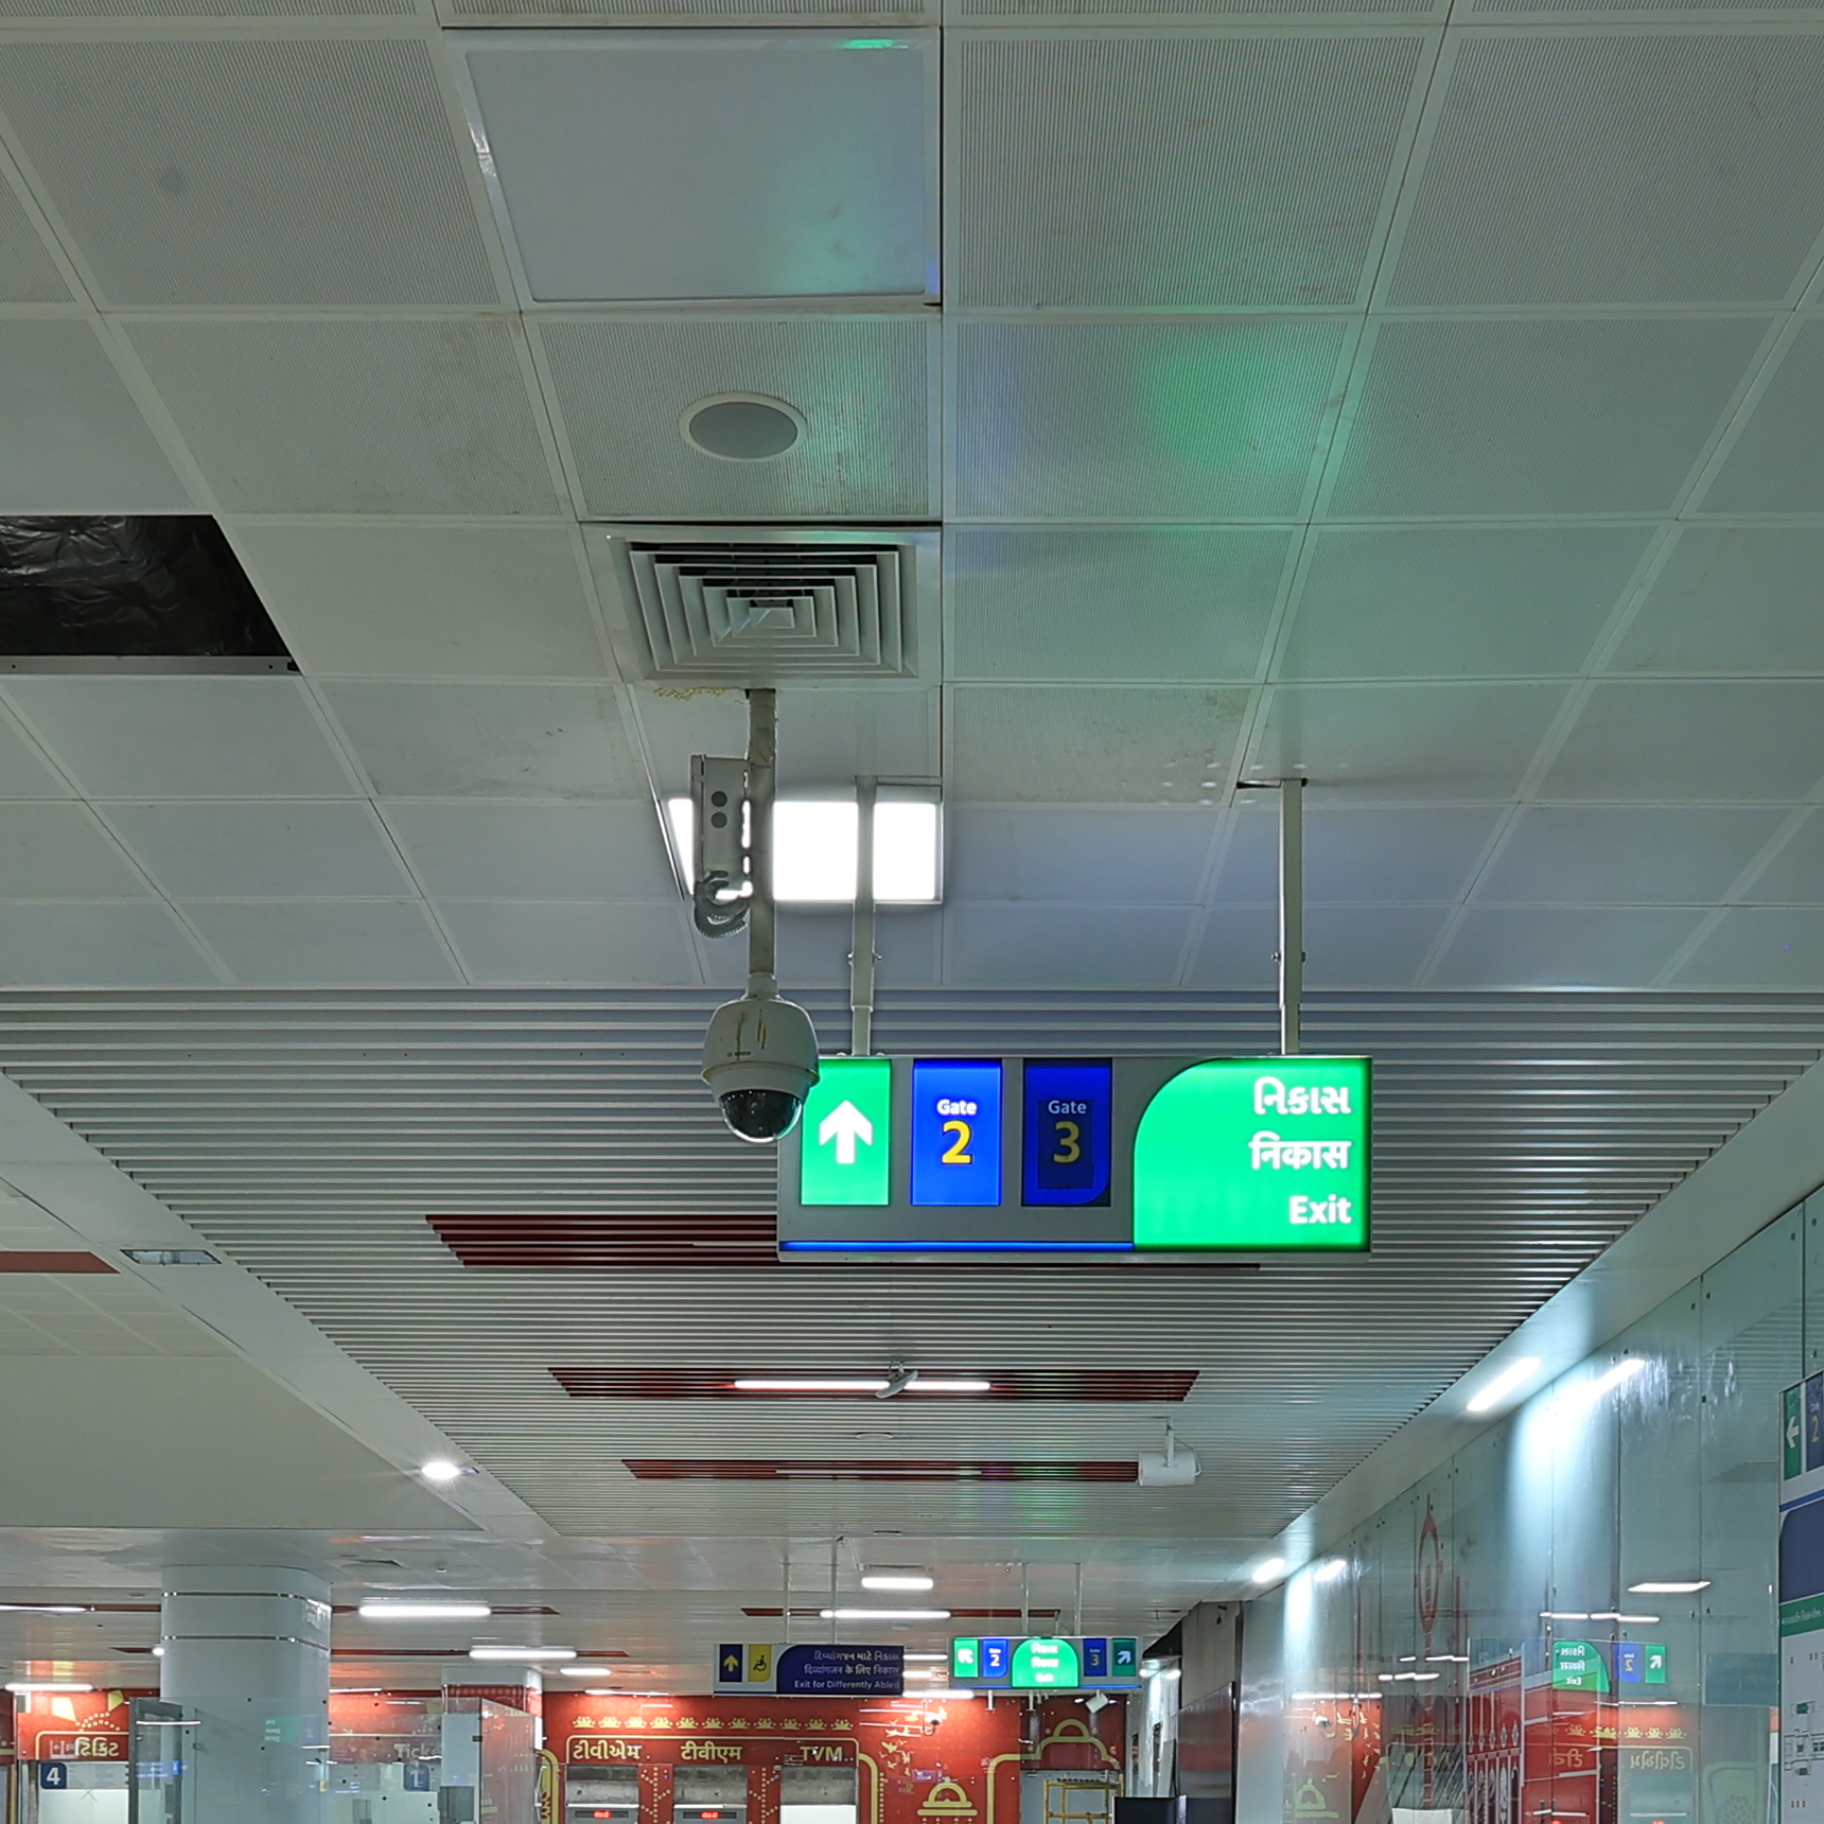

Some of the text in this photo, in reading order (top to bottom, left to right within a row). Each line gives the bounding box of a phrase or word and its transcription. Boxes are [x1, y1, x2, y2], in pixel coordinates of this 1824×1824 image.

[1252, 1076, 1353, 1116] નિકાસ
[937, 1098, 977, 1116] Gate
[1047, 1099, 1087, 1115] Gate
[941, 1120, 973, 1164] 2
[1052, 1121, 1081, 1164] 3
[1248, 1130, 1352, 1170] निकास
[1289, 1196, 1353, 1225] Exit
[1811, 1415, 1820, 1443] 2
[990, 1654, 1000, 1667] 2
[1091, 1654, 1099, 1666] 3
[794, 1680, 900, 1690] Exit for Differently Abled
[393, 1743, 442, 1758] Ticke
[572, 1739, 642, 1761] ટીવીએમ
[680, 1741, 743, 1763] टीवीएम
[800, 1746, 843, 1762] TVM
[46, 1767, 61, 1785] 4
